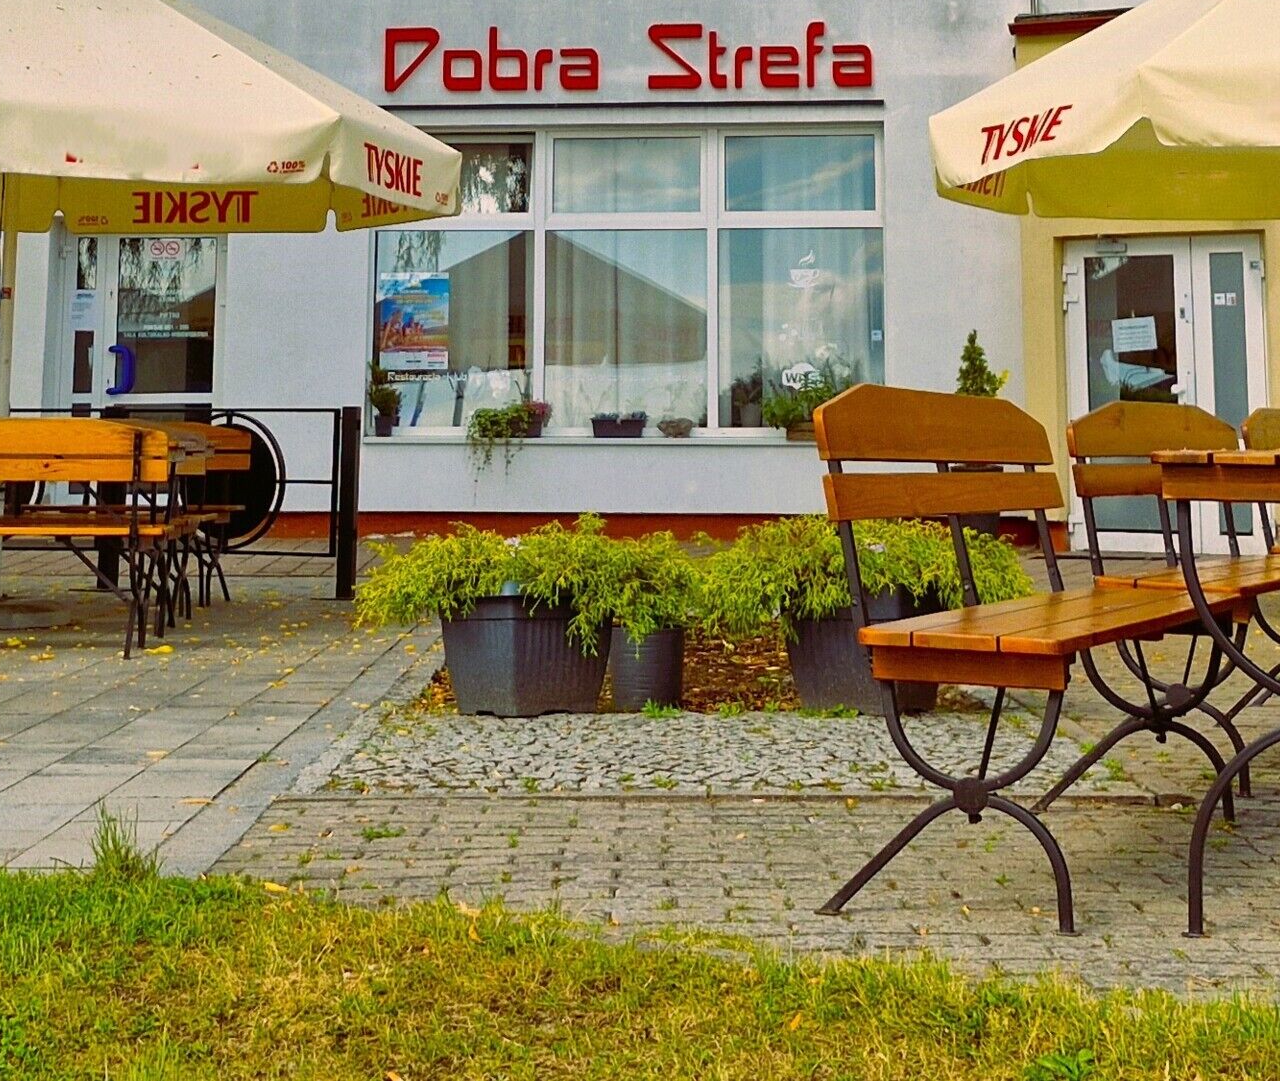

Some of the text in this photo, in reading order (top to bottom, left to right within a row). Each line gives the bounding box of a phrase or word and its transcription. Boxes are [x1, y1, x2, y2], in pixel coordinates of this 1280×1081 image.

[383, 21, 874, 93] Dobra Strefa
[363, 142, 423, 198] TYSKIE
